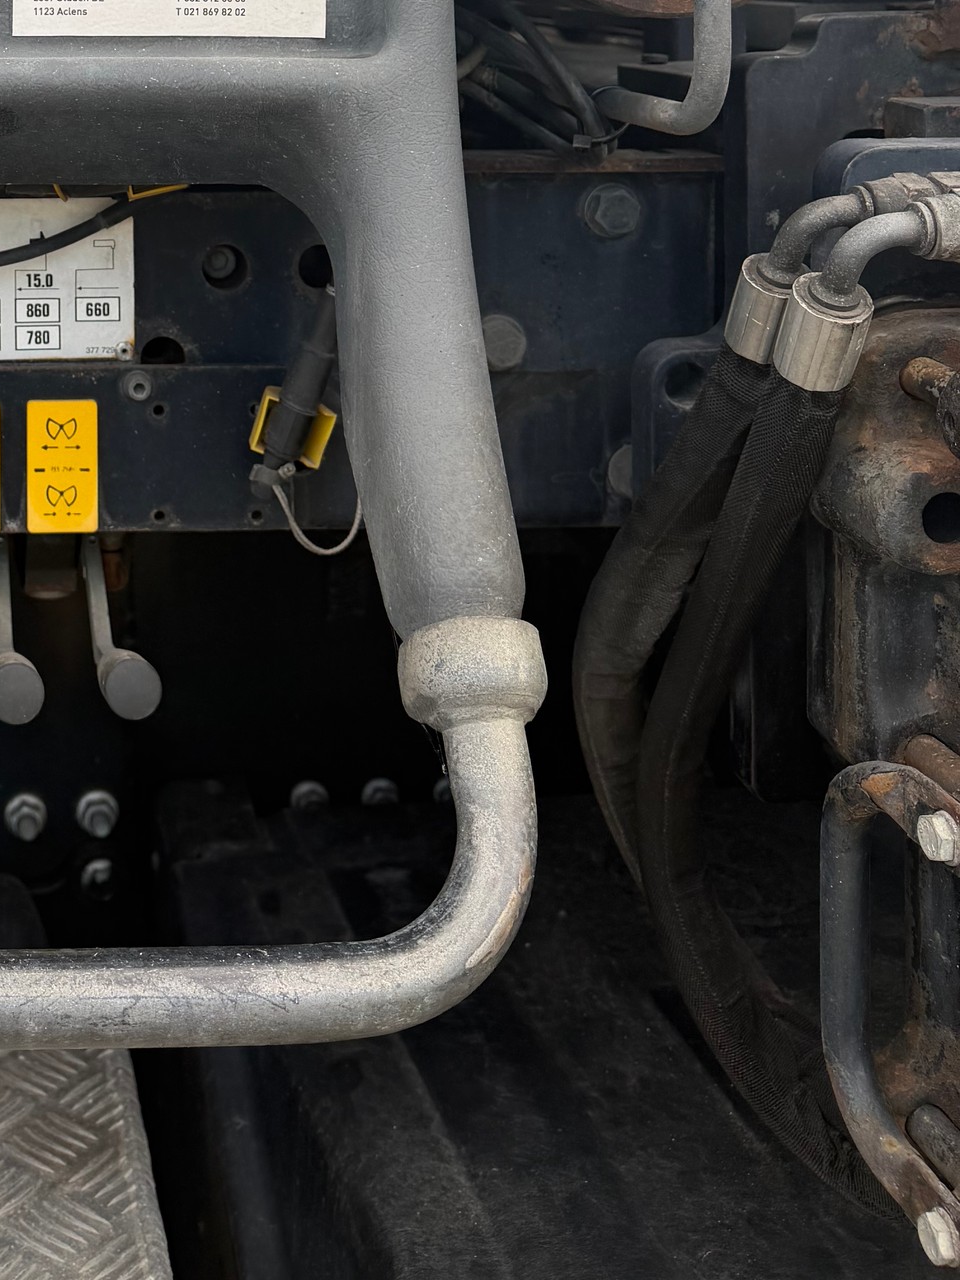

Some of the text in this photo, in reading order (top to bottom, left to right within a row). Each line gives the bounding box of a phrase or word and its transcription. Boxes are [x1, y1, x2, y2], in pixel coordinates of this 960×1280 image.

[34, 8, 87, 16] 1123 Aclens
[176, 8, 246, 16] T 021 869 82 02
[26, 274, 53, 288] 15.0
[26, 303, 50, 317] 860
[86, 302, 110, 316] 660
[26, 330, 50, 344] 780
